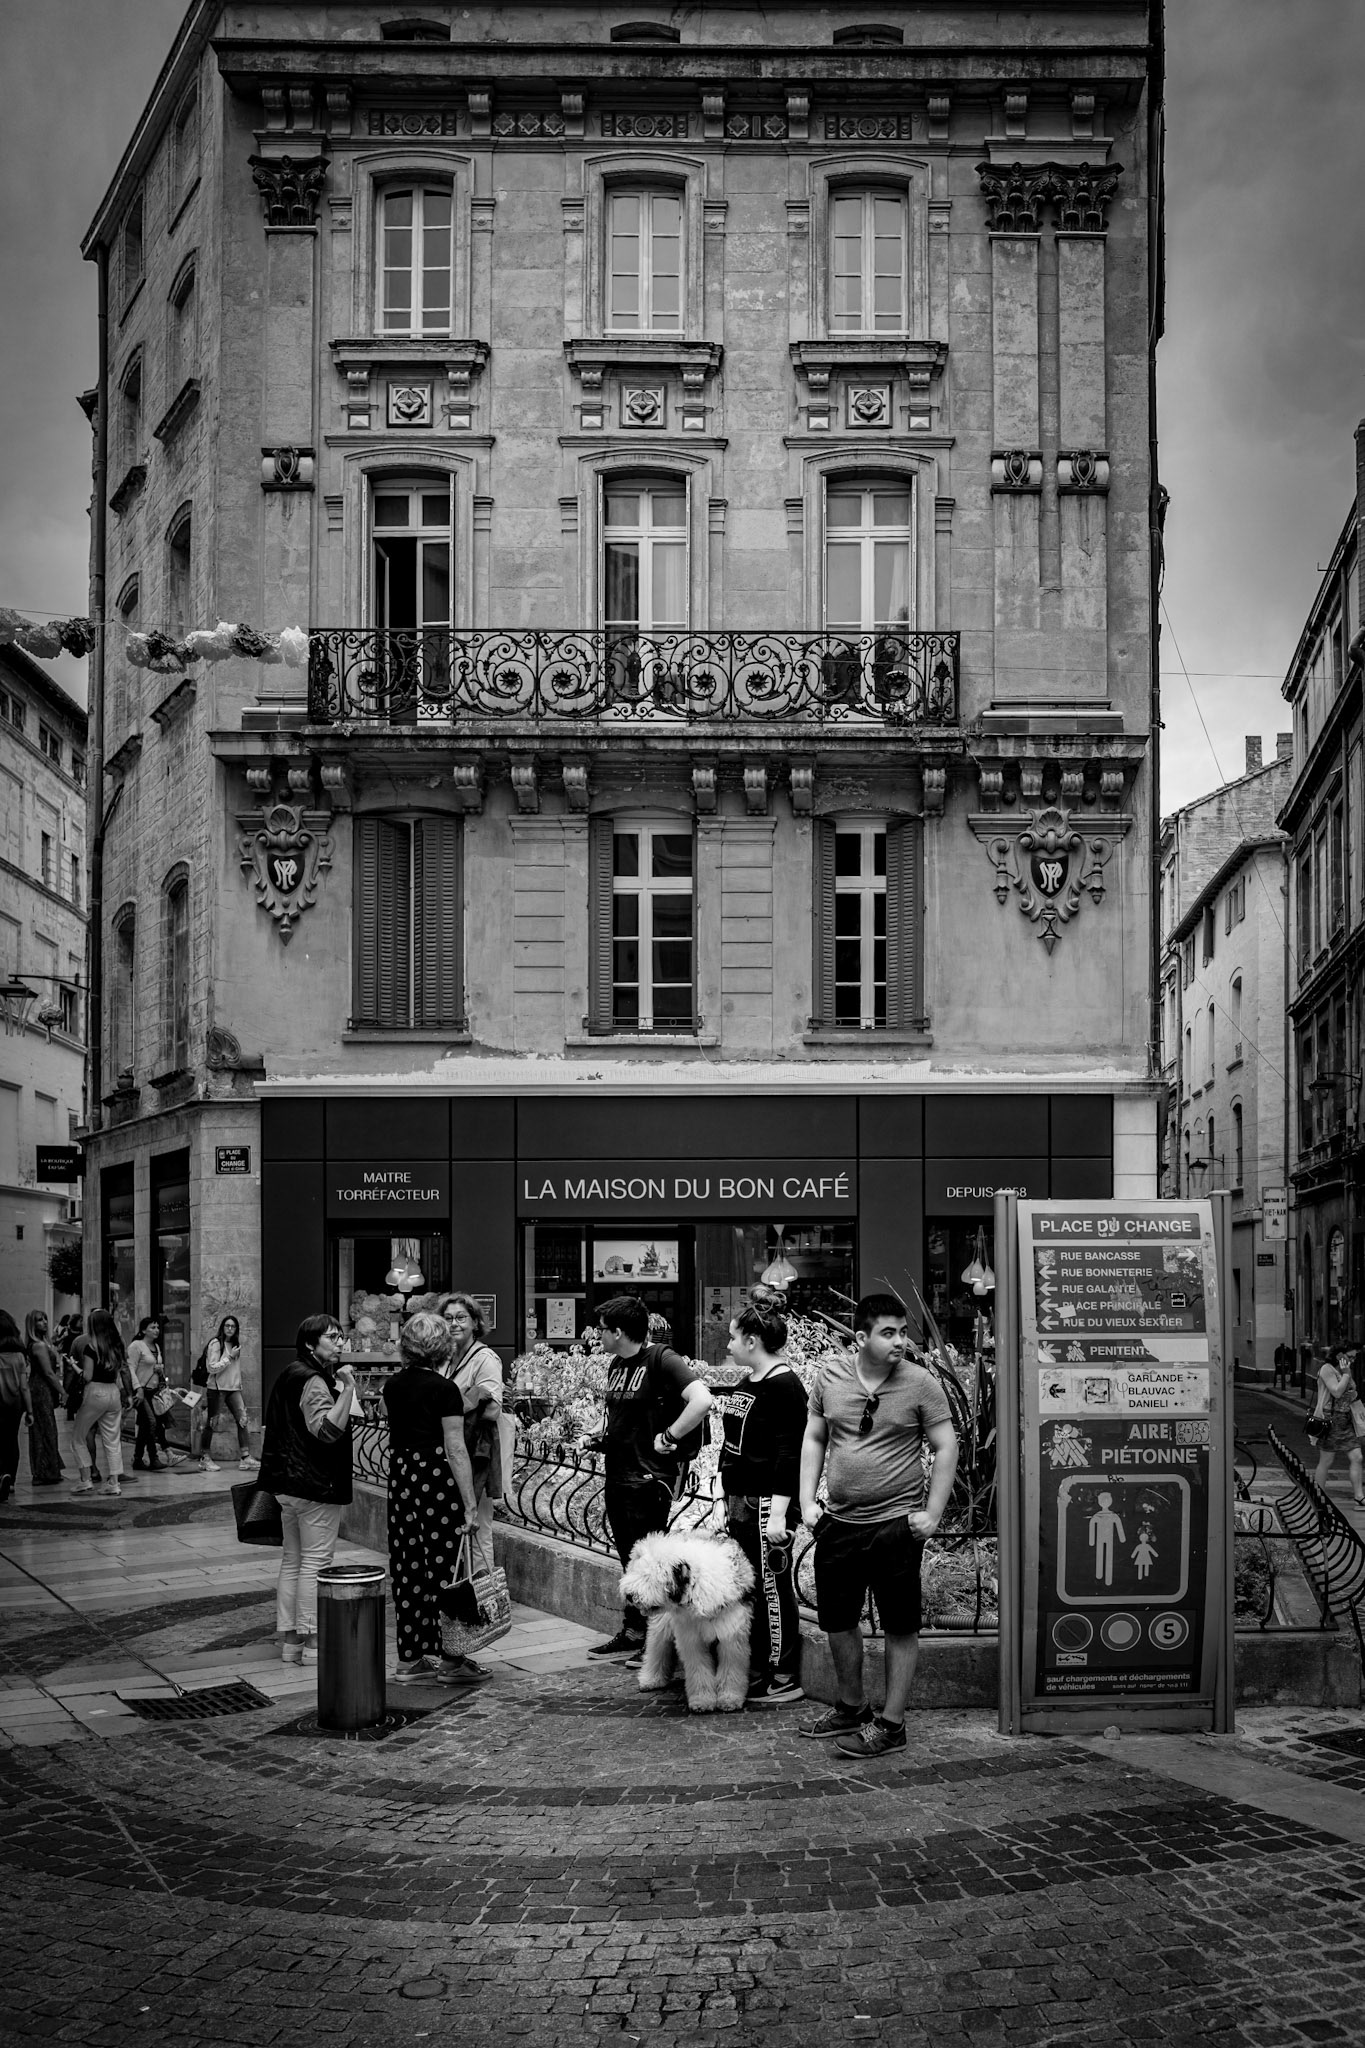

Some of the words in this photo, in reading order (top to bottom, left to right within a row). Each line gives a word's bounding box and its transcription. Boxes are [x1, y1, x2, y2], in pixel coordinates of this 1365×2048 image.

[524, 1179, 557, 1199] LA
[564, 1178, 665, 1199] MAISON
[674, 1178, 710, 1199] DU
[719, 1178, 774, 1199] BON
[782, 1171, 849, 1199] CAFÉ
[336, 1186, 440, 1200] TORRÉFACTEUR
[946, 1186, 994, 1198] DEPUIS
[1040, 1220, 1093, 1233] PLACE
[1097, 1219, 1120, 1233] DU
[1124, 1219, 1192, 1233] CHANGE
[1060, 1252, 1083, 1261] RUE
[1084, 1251, 1141, 1261] BANCASSE
[1061, 1268, 1083, 1277] RUE
[1085, 1268, 1153, 1277] BONNETERIE
[1062, 1284, 1084, 1294] RUE
[1086, 1284, 1136, 1294] GALANTE
[1099, 1301, 1162, 1310] PRINCIPALE
[1063, 1318, 1085, 1327] RUE
[1087, 1318, 1103, 1327] DU
[1105, 1318, 1137, 1327] VIEUX
[1138, 1317, 1183, 1327] SEXTIER
[1128, 1374, 1184, 1383] GARLANDE
[1128, 1387, 1176, 1395] BLAUVAC
[1128, 1400, 1169, 1408] DANIELI
[1128, 1423, 1169, 1439] AIRE
[1101, 1445, 1198, 1464] PIÉTONNE
[1163, 1622, 1175, 1640] 5
[1046, 1675, 1065, 1683] sauf
[1065, 1674, 1118, 1684] chargements
[1119, 1674, 1127, 1682] et
[1128, 1672, 1191, 1682] déchargements
[1046, 1683, 1057, 1691] de
[1058, 1682, 1096, 1691] véhicules
